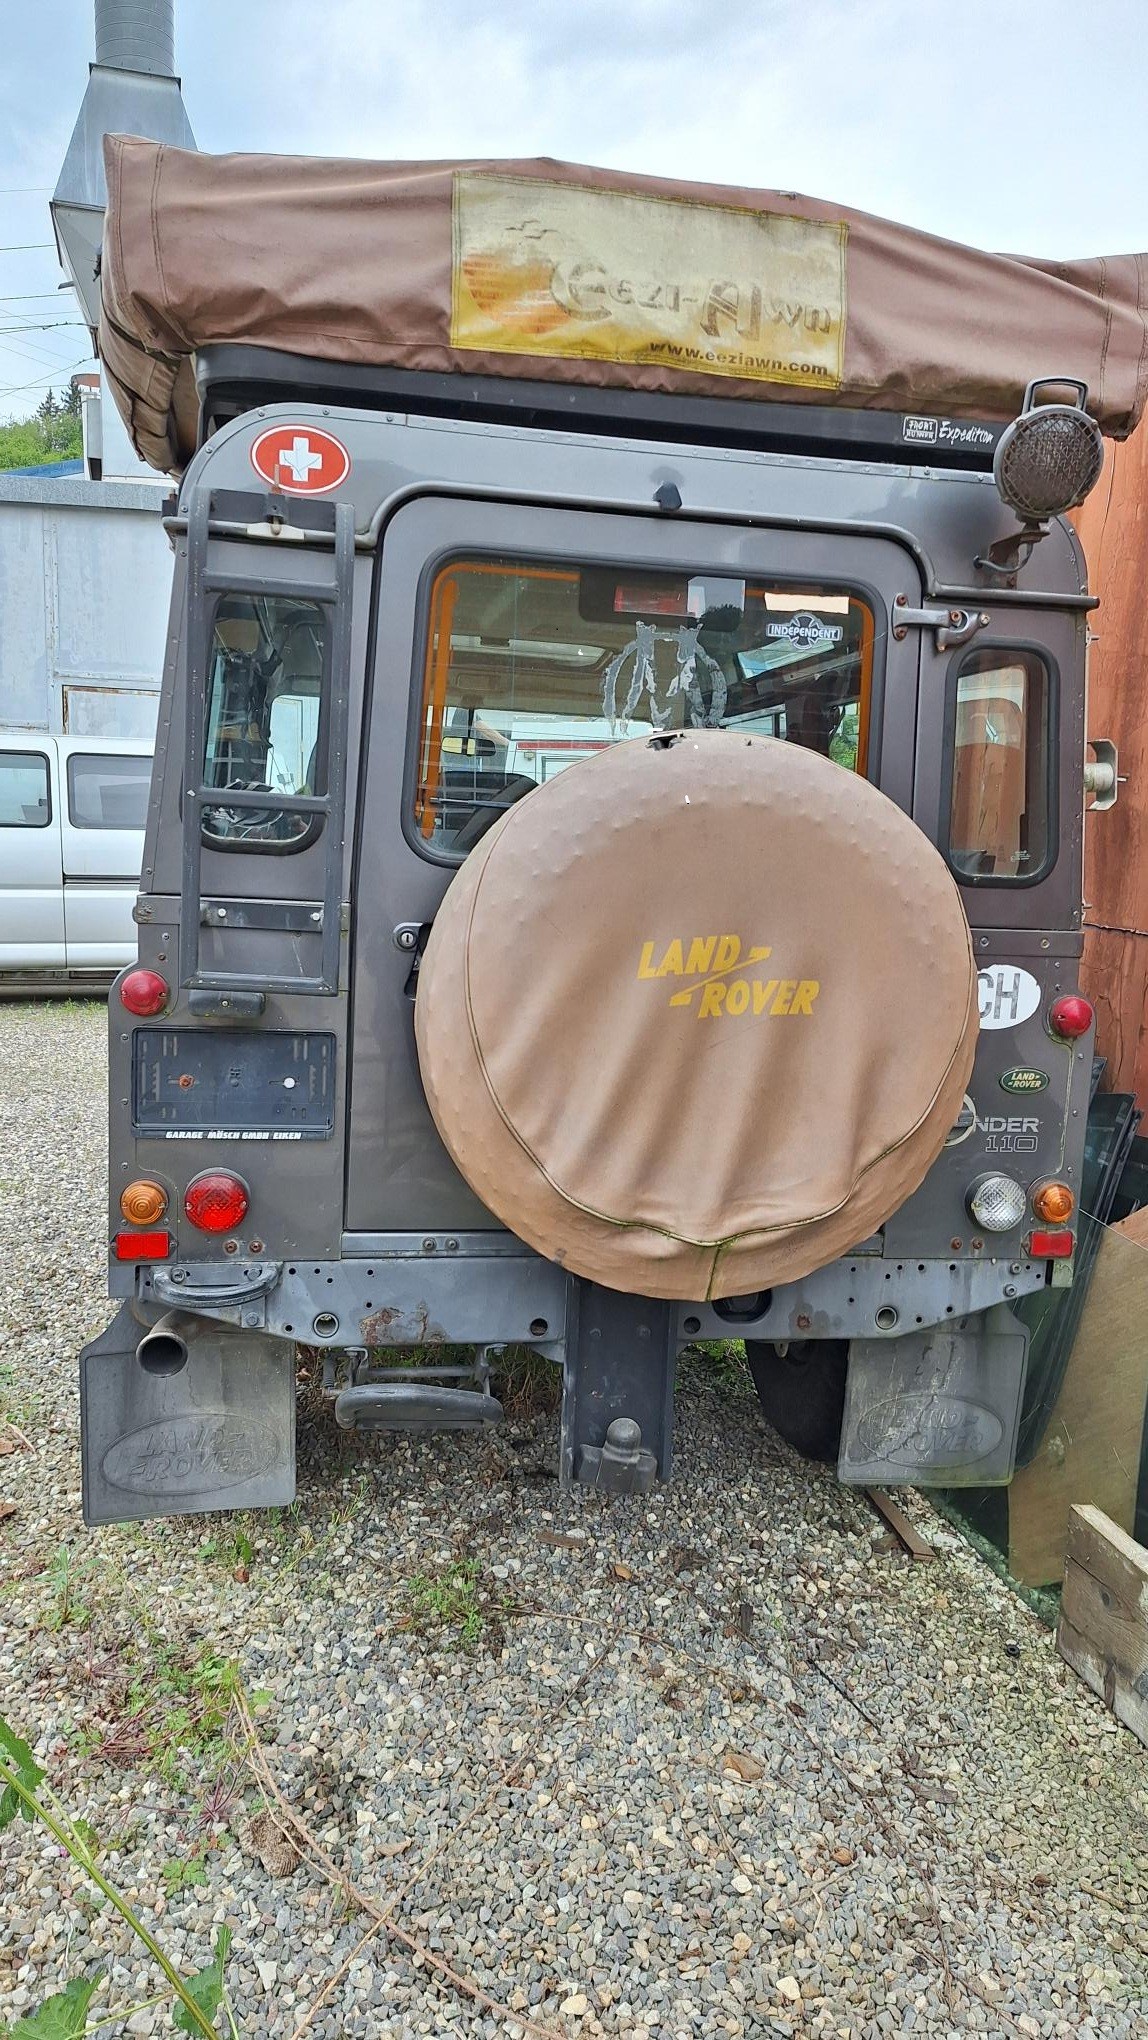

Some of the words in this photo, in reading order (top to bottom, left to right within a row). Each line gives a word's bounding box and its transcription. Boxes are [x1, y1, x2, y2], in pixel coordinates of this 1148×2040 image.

[649, 341, 829, 377] www.eeziawn.com
[938, 420, 995, 446] Expedition
[771, 625, 837, 639] INDEPENDENT
[637, 934, 741, 979] LAND
[698, 979, 820, 1018] ROVER
[978, 972, 1021, 1019] CH
[1011, 1072, 1035, 1081] LAND
[1012, 1080, 1042, 1088] ROVER
[165, 1131, 204, 1139] GARAGE
[272, 1132, 302, 1140] EIKEN
[985, 1135, 1038, 1153] 110
